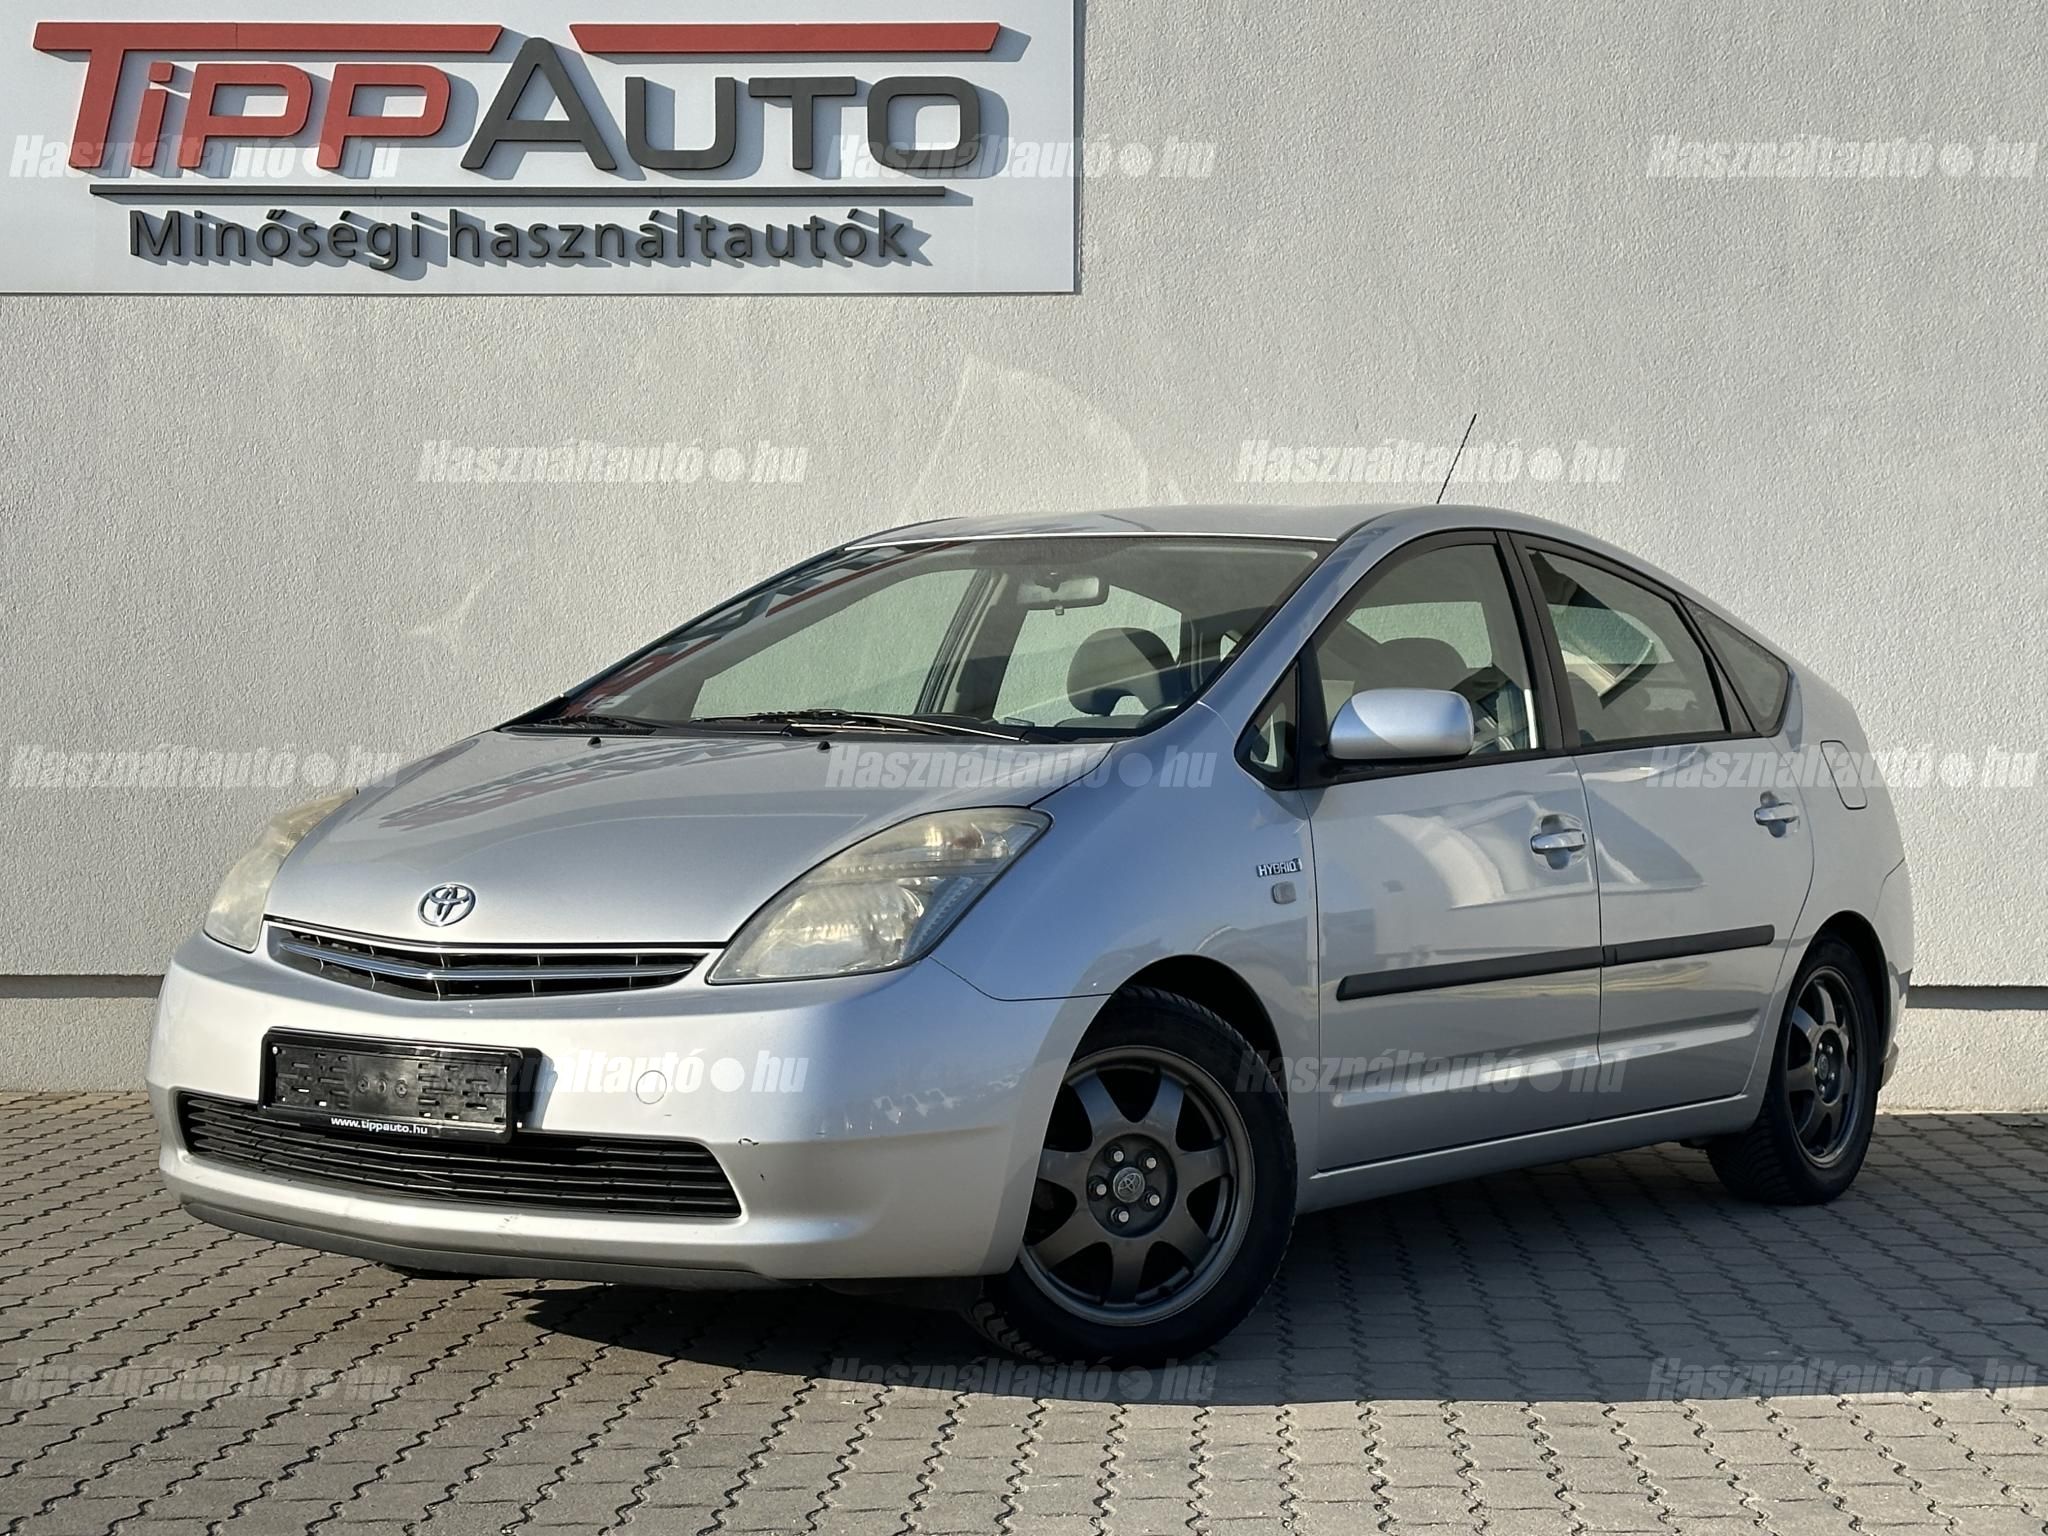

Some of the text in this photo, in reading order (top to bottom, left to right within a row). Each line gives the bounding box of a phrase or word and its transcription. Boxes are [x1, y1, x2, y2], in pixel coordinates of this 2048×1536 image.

[130, 208, 908, 270] Minőségi használtautók
[1257, 860, 1298, 877] HYBRID
[330, 1117, 428, 1135] www.tippauto.hu
